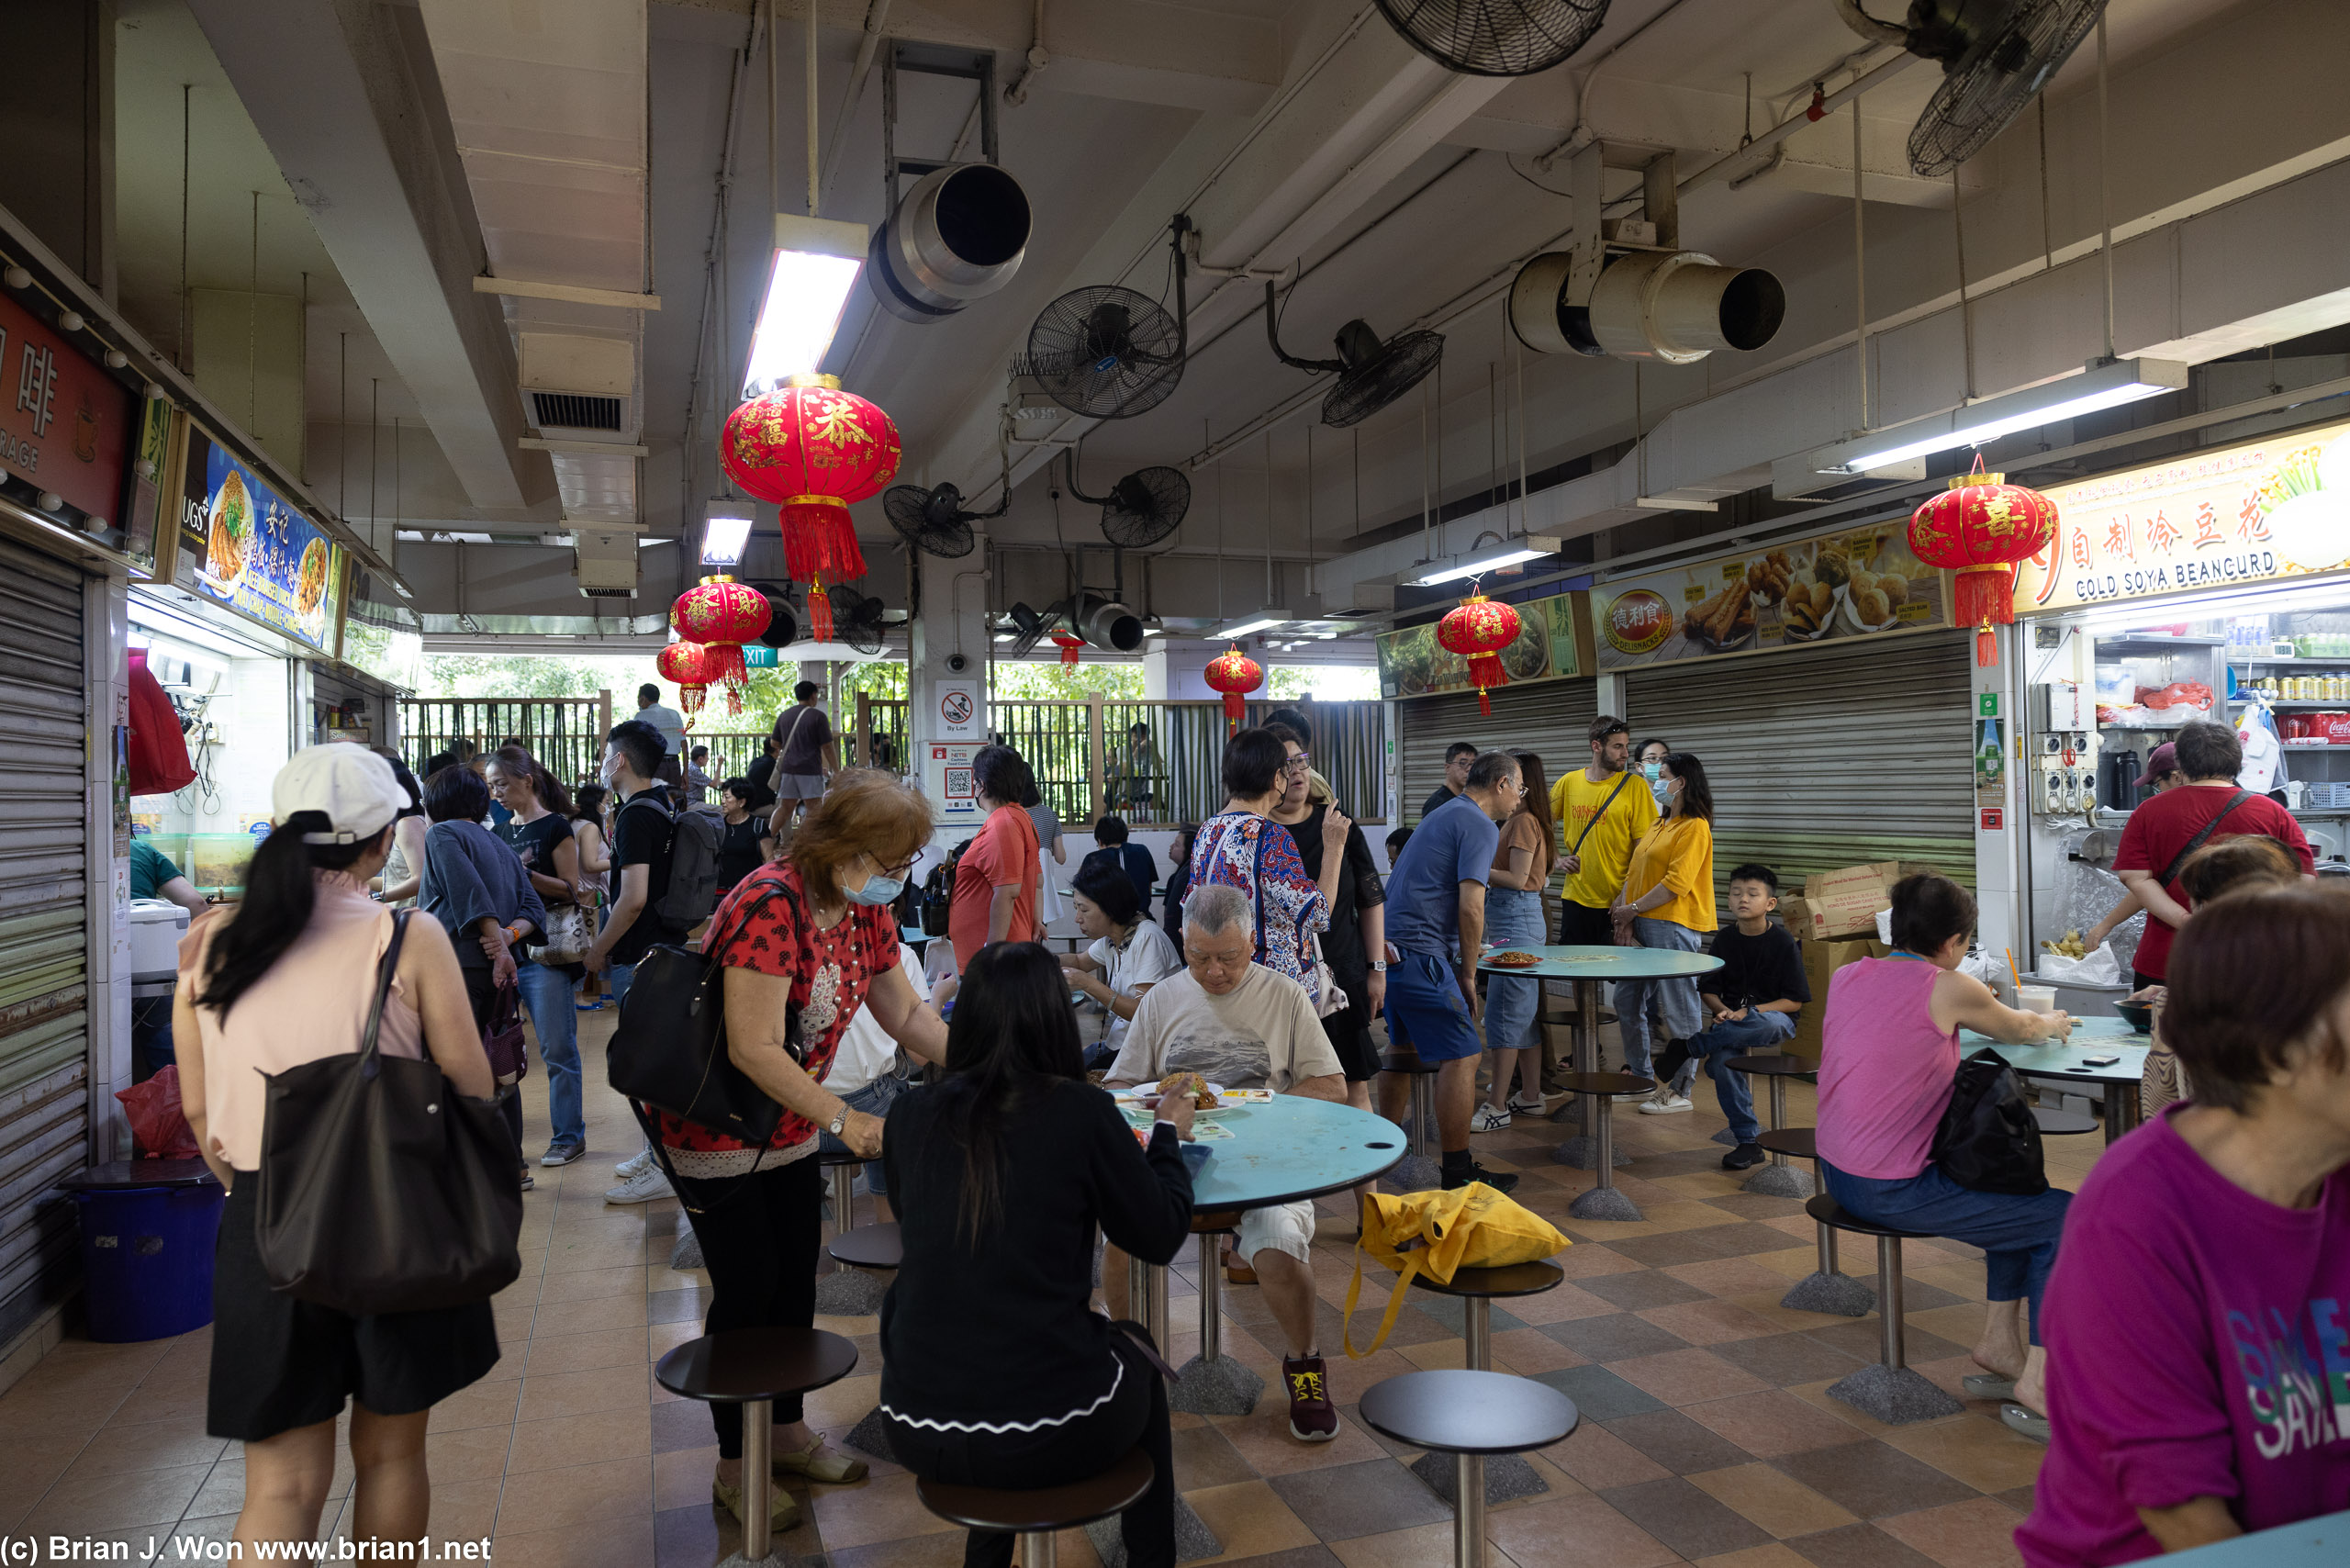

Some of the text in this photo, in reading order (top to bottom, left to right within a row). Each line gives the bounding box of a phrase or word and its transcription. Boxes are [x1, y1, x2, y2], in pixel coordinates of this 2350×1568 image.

[248, 568, 259, 592] KEE
[2076, 551, 2275, 599] COLD SOYA BEANCURD
[1612, 600, 1660, 631] 德利食
[1619, 633, 1660, 652] DELISNACKS
